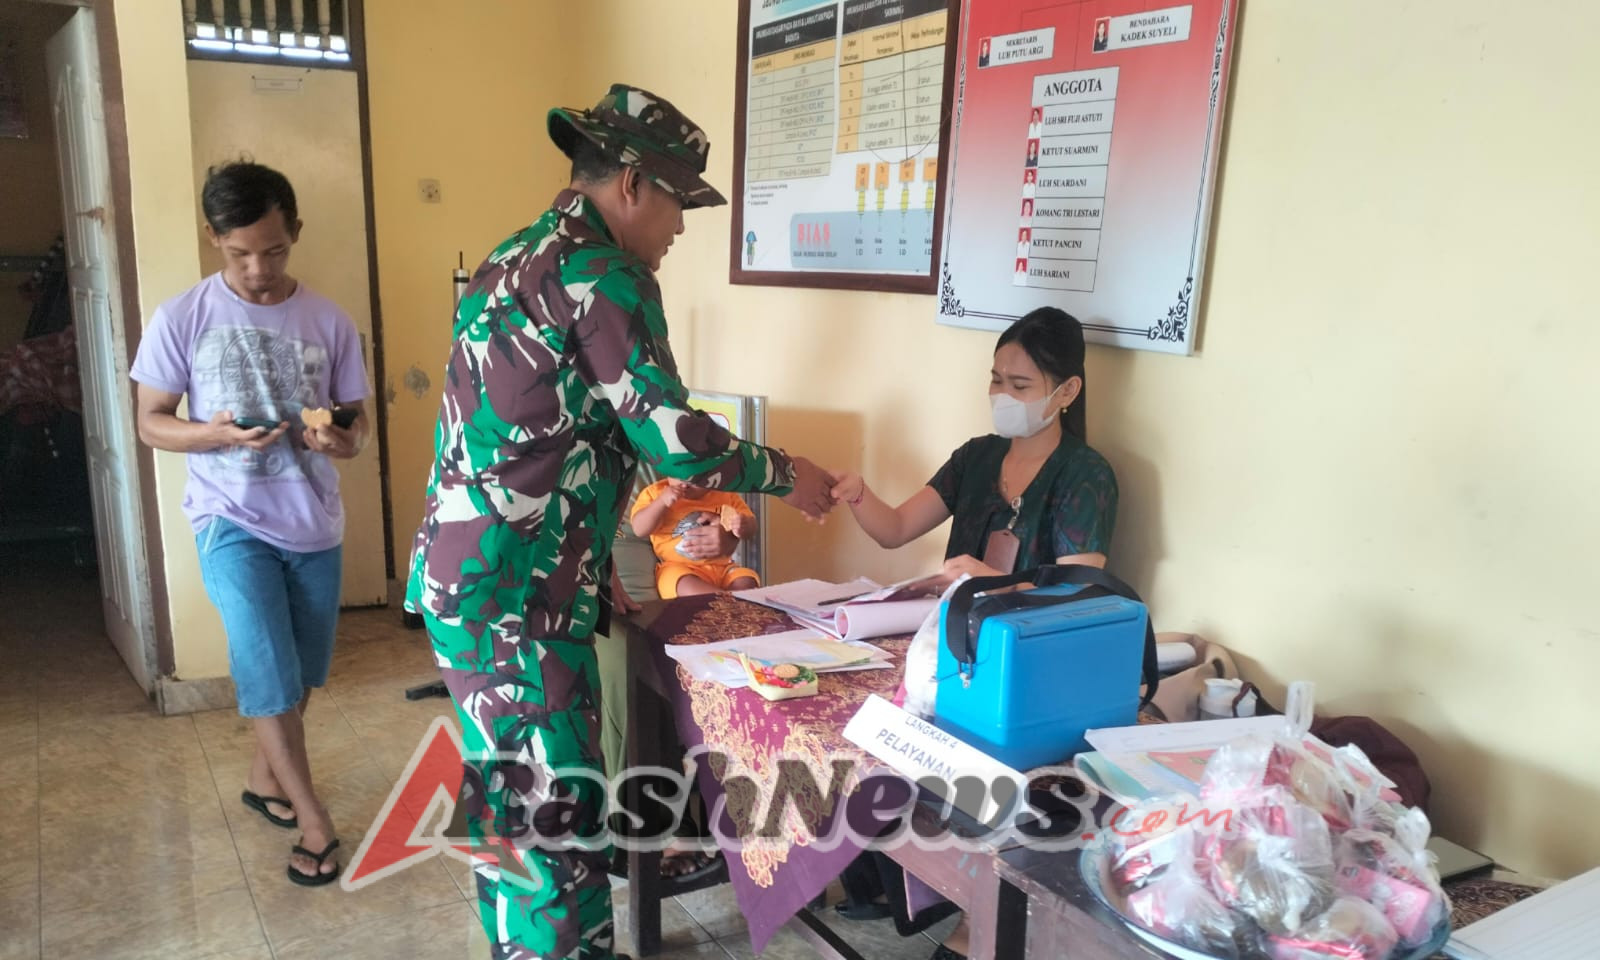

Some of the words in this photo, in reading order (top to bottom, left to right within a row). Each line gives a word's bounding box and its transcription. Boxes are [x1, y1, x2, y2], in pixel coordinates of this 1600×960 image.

[1129, 15, 1170, 28] BENDAHARA
[1120, 31, 1147, 43] KADEK
[1148, 27, 1177, 39] SUYELI
[1006, 36, 1038, 47] SEKRETARIS
[998, 51, 1011, 60] LUH
[1011, 48, 1027, 58] PUTU
[1028, 46, 1044, 56] ARGI
[1044, 78, 1102, 97] ANGGOTA
[1044, 116, 1057, 125] LUH
[1057, 115, 1067, 124] SRI
[1081, 113, 1103, 123] ASTUTI
[1042, 147, 1063, 156] KETUT
[1064, 145, 1099, 155] SUARMINI
[1039, 179, 1052, 188] LUH
[1053, 178, 1087, 188] SUARDANI
[1036, 208, 1062, 217] KOMANG
[1062, 209, 1072, 217] TRI
[1073, 209, 1100, 217] LESTARI
[1033, 239, 1054, 247] KETUT
[1054, 240, 1082, 249] PANCINI
[1030, 268, 1043, 277] LUH
[1044, 270, 1070, 279] SARIANI
[904, 715, 951, 745] LANGKAH
[950, 740, 958, 749] 4
[876, 728, 958, 781] PELAYANAN
